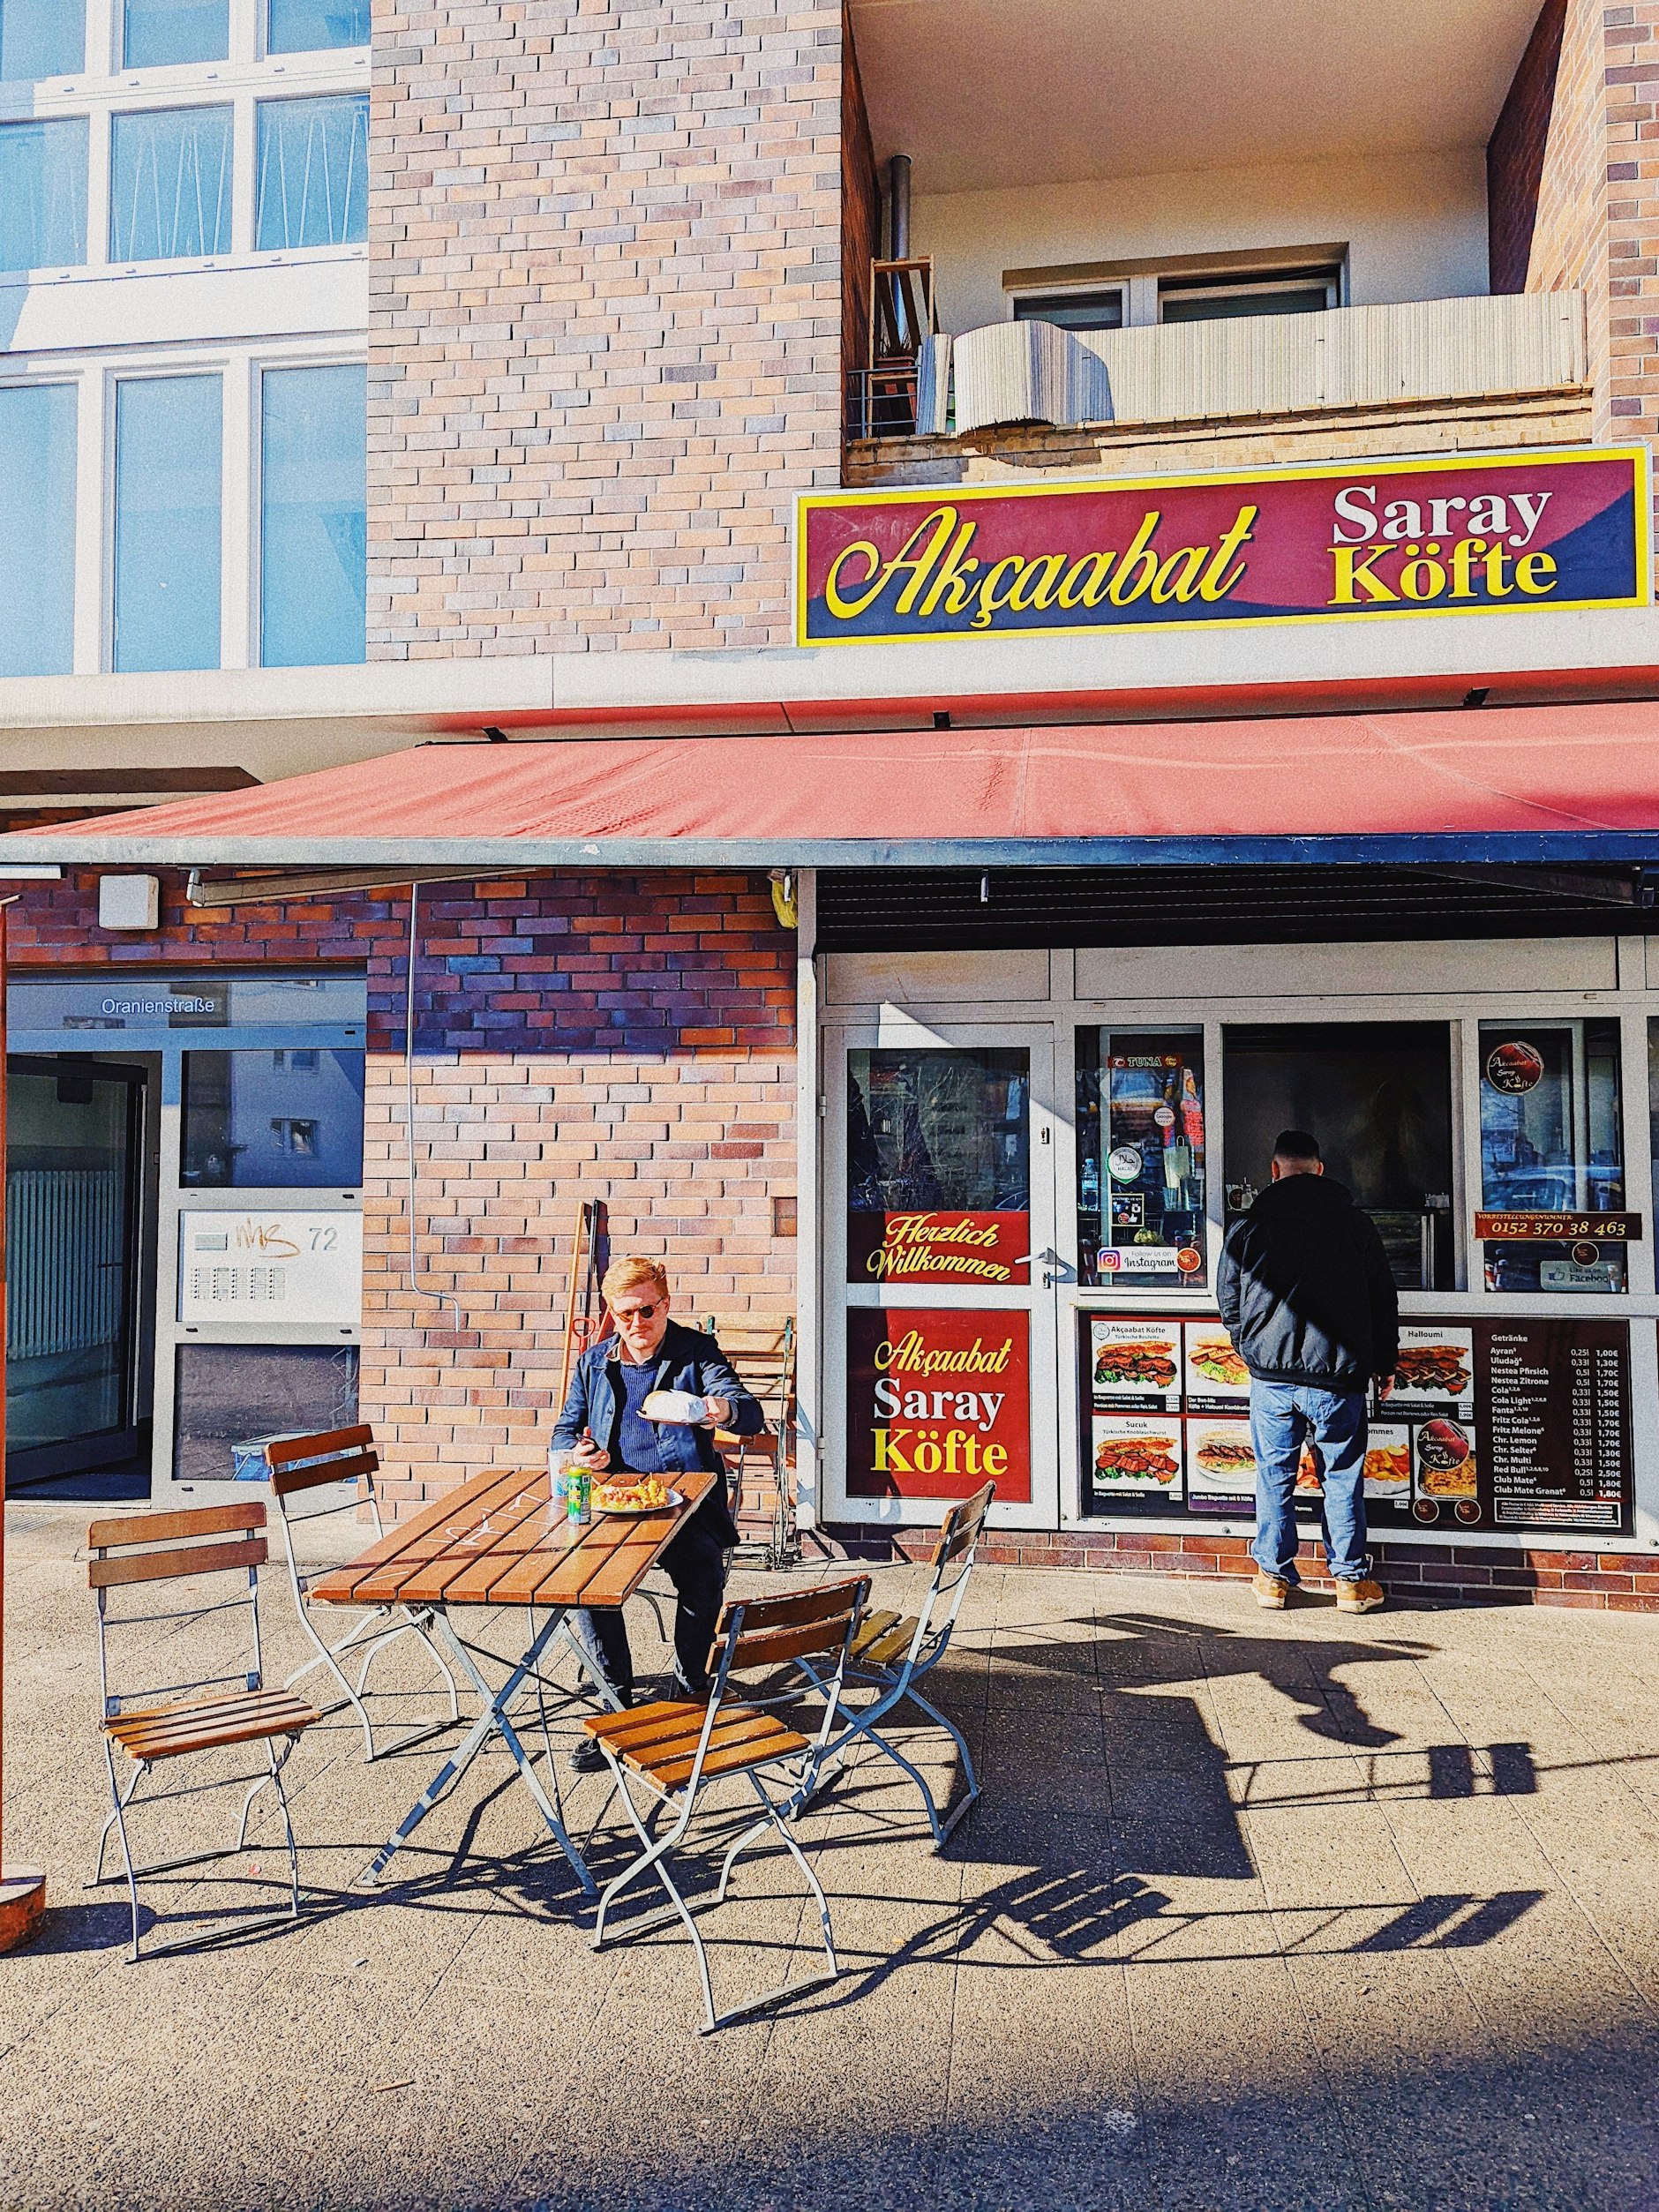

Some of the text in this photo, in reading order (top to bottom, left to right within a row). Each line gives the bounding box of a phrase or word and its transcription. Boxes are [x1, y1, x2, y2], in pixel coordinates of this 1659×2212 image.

[1332, 485, 1554, 547] Saray
[824, 503, 1260, 628] Akçaabat
[1326, 536, 1558, 605] Köfte
[101, 997, 214, 1013] Oranienstraße
[1127, 1056, 1162, 1067] TUNA
[882, 1212, 999, 1248] Herzlich
[1491, 1221, 1626, 1236] 0152 370 38 463
[309, 1227, 338, 1251] 72
[866, 1245, 1011, 1282] Willkommen
[1124, 1256, 1175, 1271] Instagram
[1570, 1274, 1609, 1283] Faceboo
[1490, 1334, 1528, 1343] Getränke
[874, 1330, 1012, 1377] Akçaabat
[1595, 1349, 1618, 1358] 1,00€
[874, 1377, 1005, 1431] Saray
[1598, 1439, 1620, 1448] 1,70€
[870, 1428, 1009, 1475] Köfte
[1510, 1456, 1532, 1465] Multi
[1598, 1480, 1621, 1488] 1,80€
[1599, 1489, 1622, 1498] 1,80€
